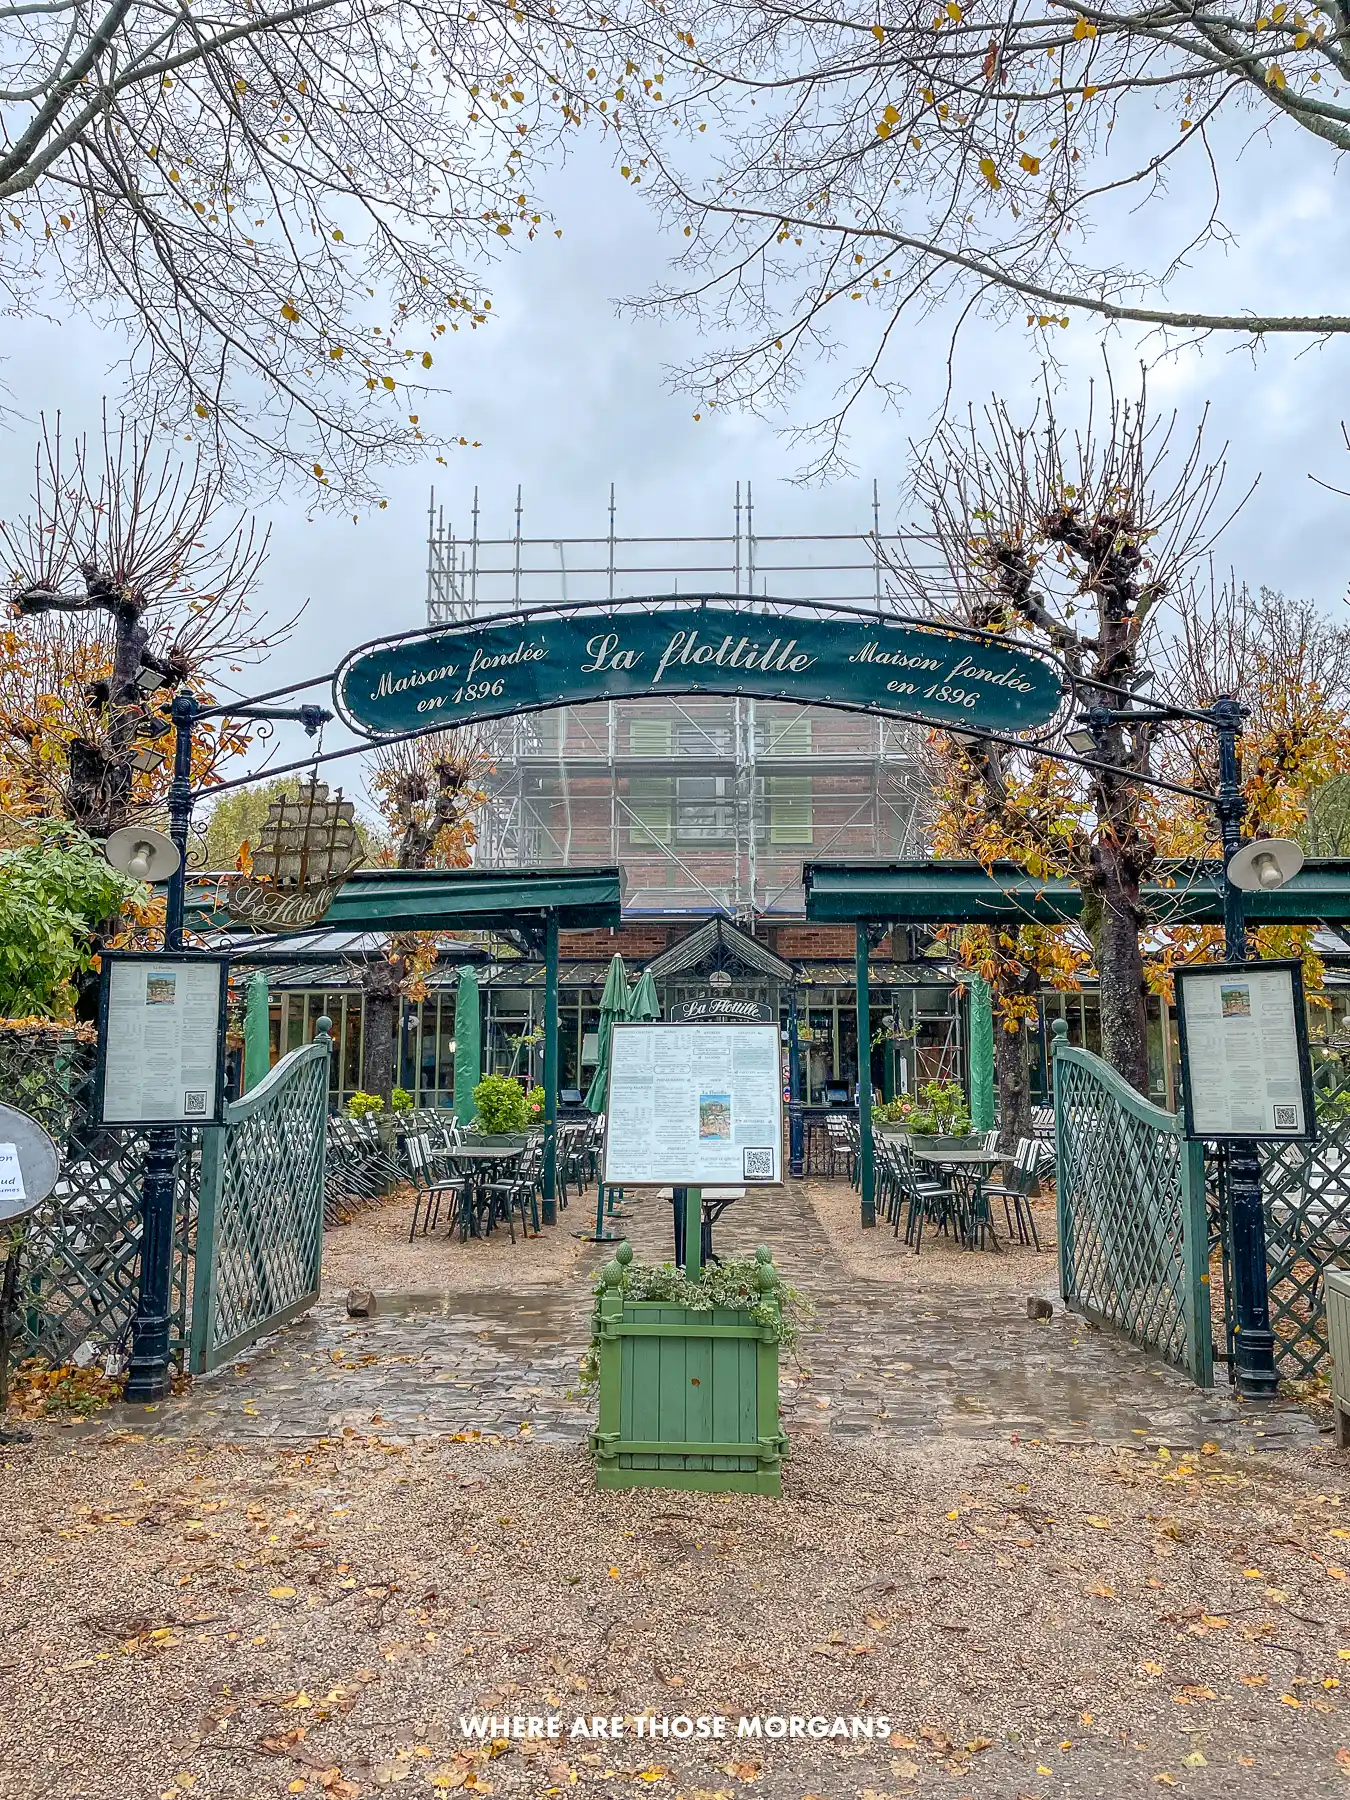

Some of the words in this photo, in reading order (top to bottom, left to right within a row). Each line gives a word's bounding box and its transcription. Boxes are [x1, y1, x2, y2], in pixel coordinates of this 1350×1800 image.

[370, 663, 460, 700] Maison
[466, 641, 550, 682] fondée
[580, 633, 645, 673] La
[652, 630, 819, 683] flottille
[848, 641, 944, 671] Maison
[943, 655, 1037, 693] fondée
[416, 695, 448, 713] en
[451, 678, 505, 704] 1896
[886, 679, 921, 695] en
[922, 683, 981, 708] 1896
[229, 885, 270, 921] La
[682, 1001, 706, 1018] La
[708, 999, 762, 1018] Flottille
